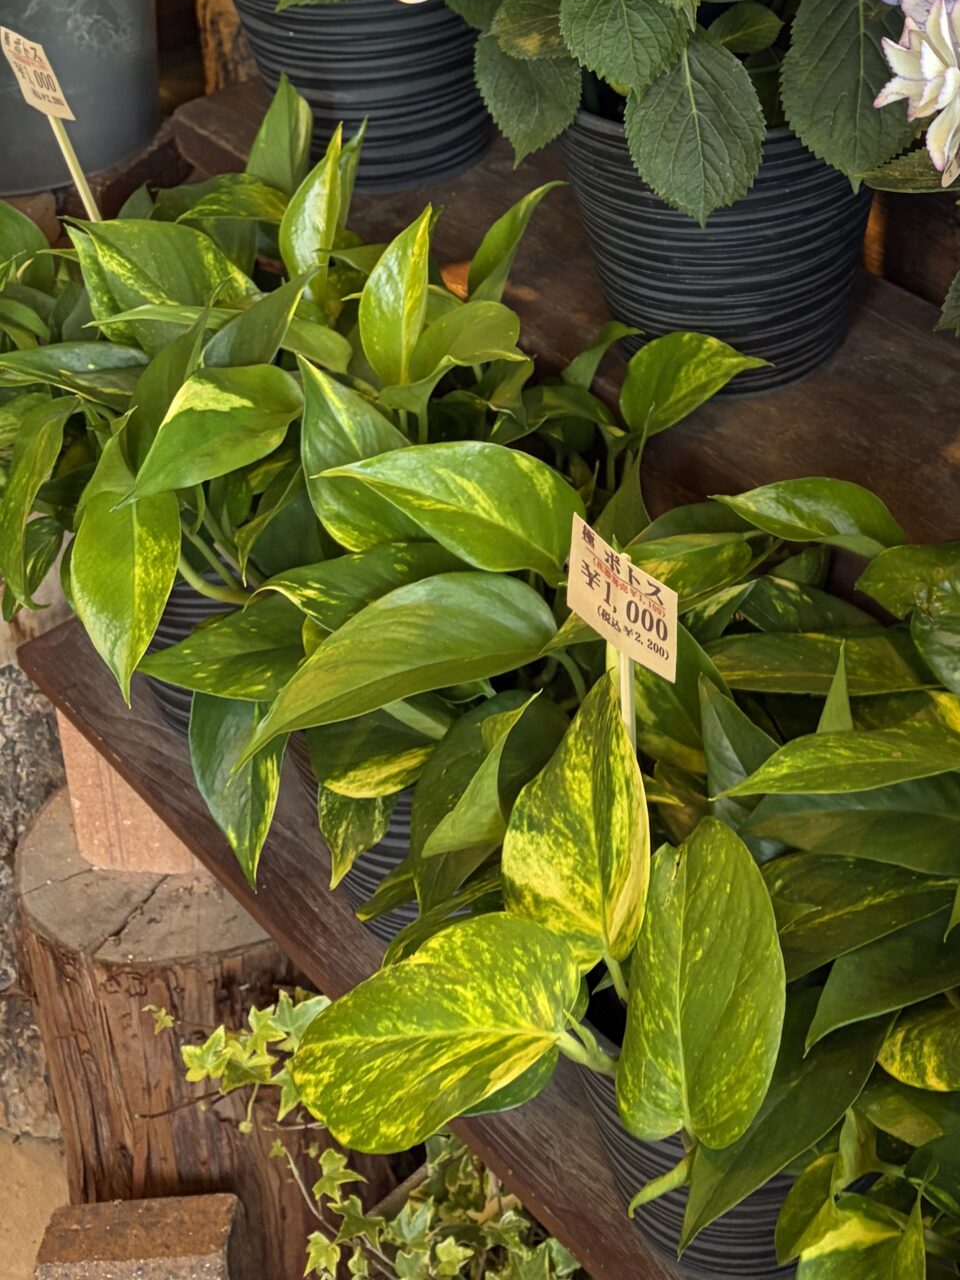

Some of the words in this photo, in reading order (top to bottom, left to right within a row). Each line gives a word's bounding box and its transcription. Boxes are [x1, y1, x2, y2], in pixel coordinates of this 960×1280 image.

[581, 559, 668, 642] ¥1,000
[604, 550, 664, 606] ポトス
